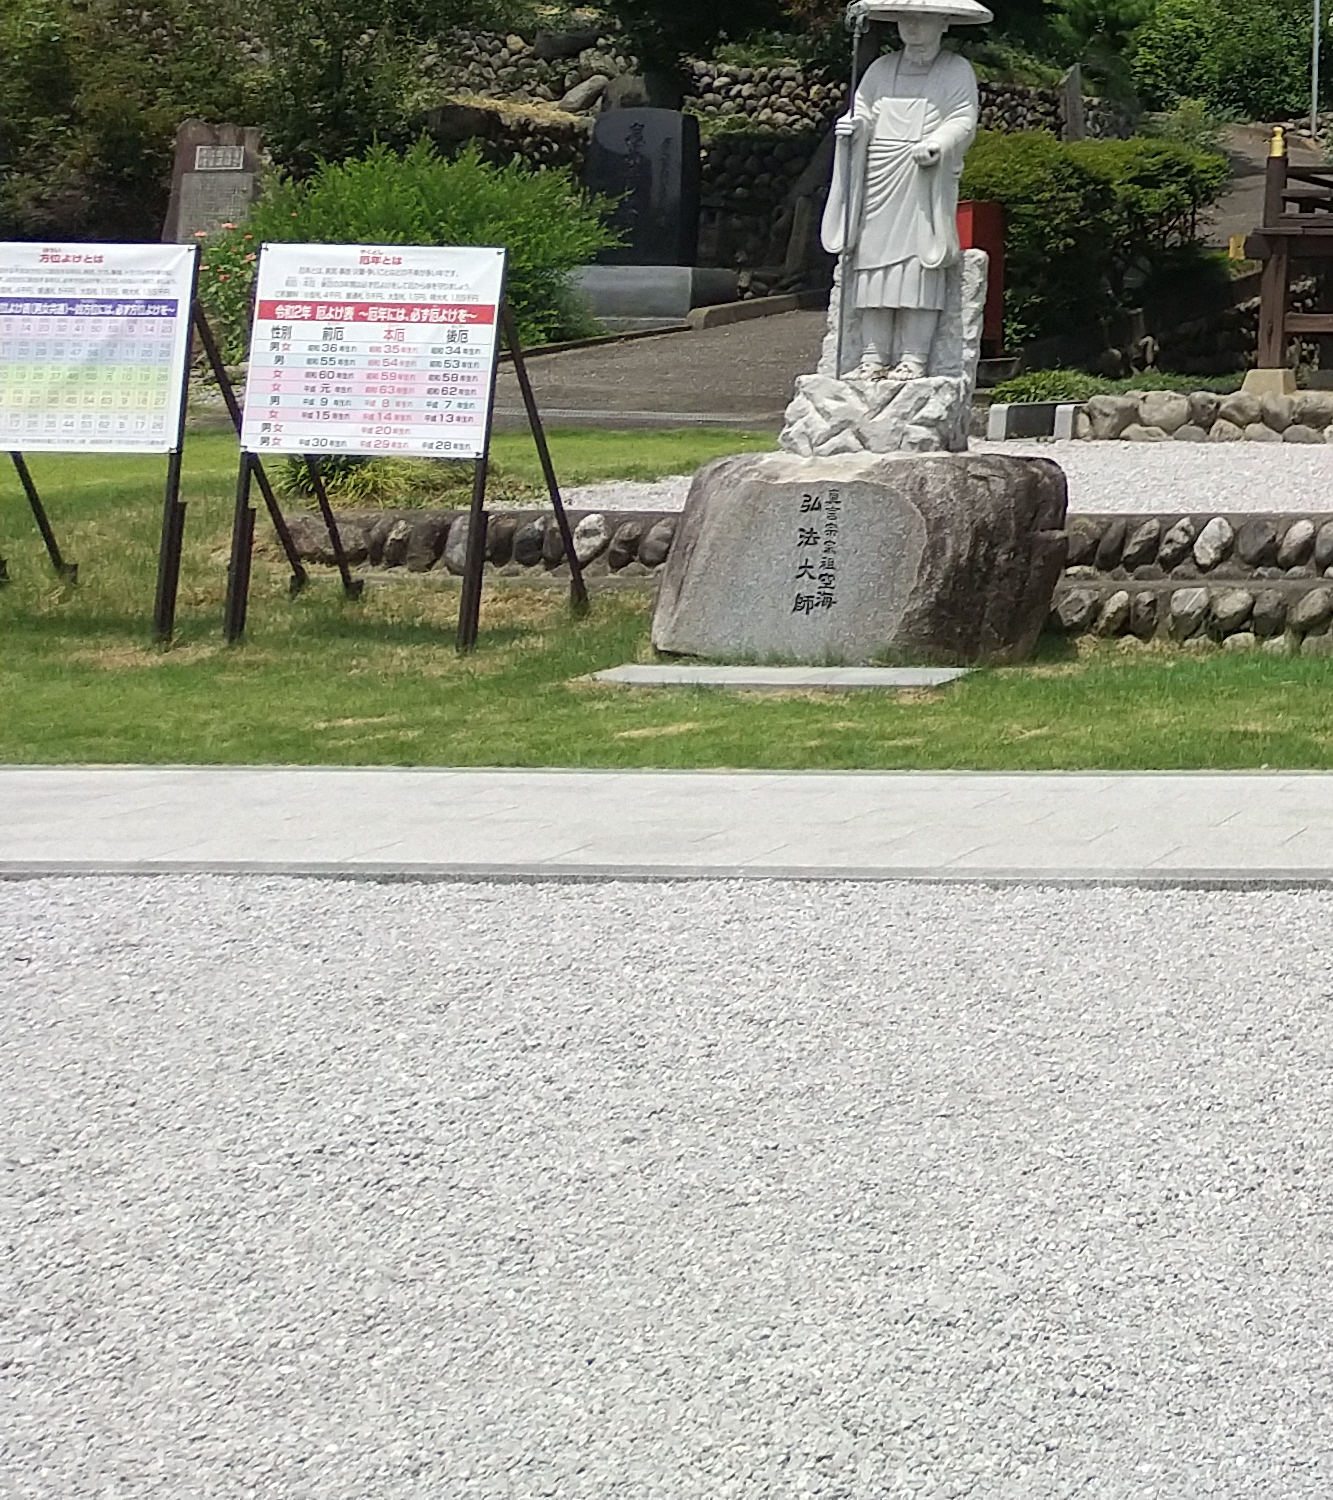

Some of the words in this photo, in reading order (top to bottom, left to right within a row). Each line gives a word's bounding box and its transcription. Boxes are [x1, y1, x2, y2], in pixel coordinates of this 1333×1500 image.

[359, 255, 402, 265] 厄年とは
[274, 305, 311, 319] 令和2年
[271, 325, 292, 339] 性別
[322, 326, 345, 341] 前厄
[383, 328, 405, 342] 本厄
[447, 329, 469, 343] 後厄
[791, 493, 822, 616] 弘法大師
